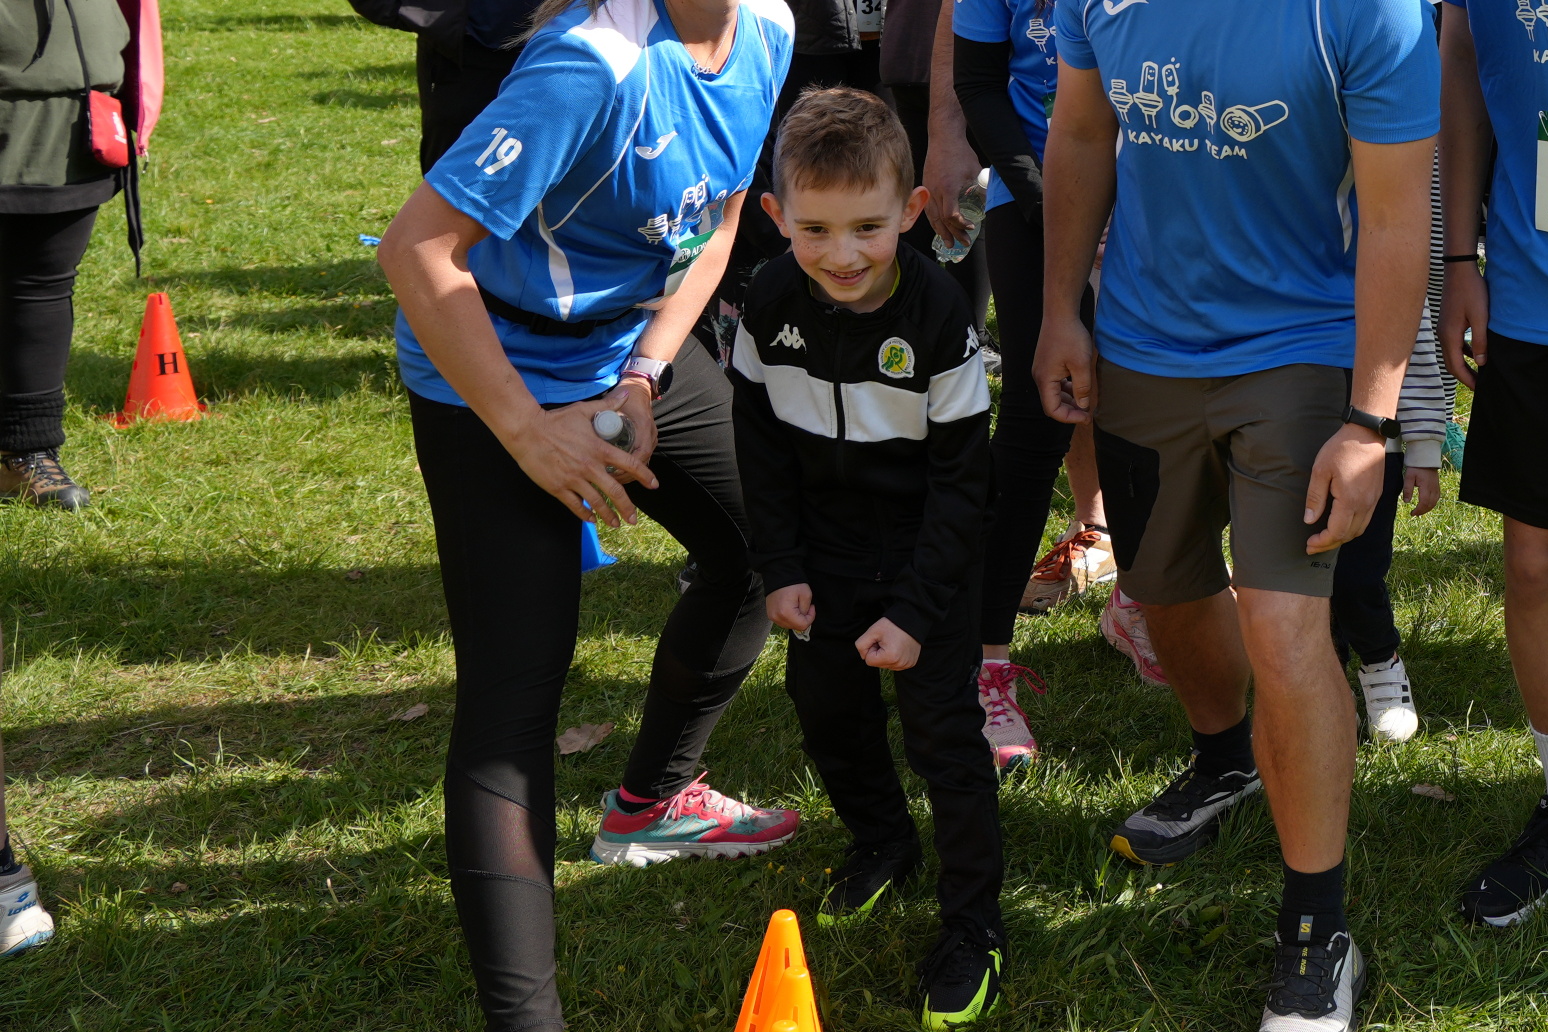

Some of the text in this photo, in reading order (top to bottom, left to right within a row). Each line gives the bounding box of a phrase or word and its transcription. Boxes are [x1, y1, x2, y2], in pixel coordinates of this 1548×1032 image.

[475, 128, 522, 175] 19
[1128, 129, 1248, 159] KAYAKU TEAM
[154, 352, 180, 376] H
